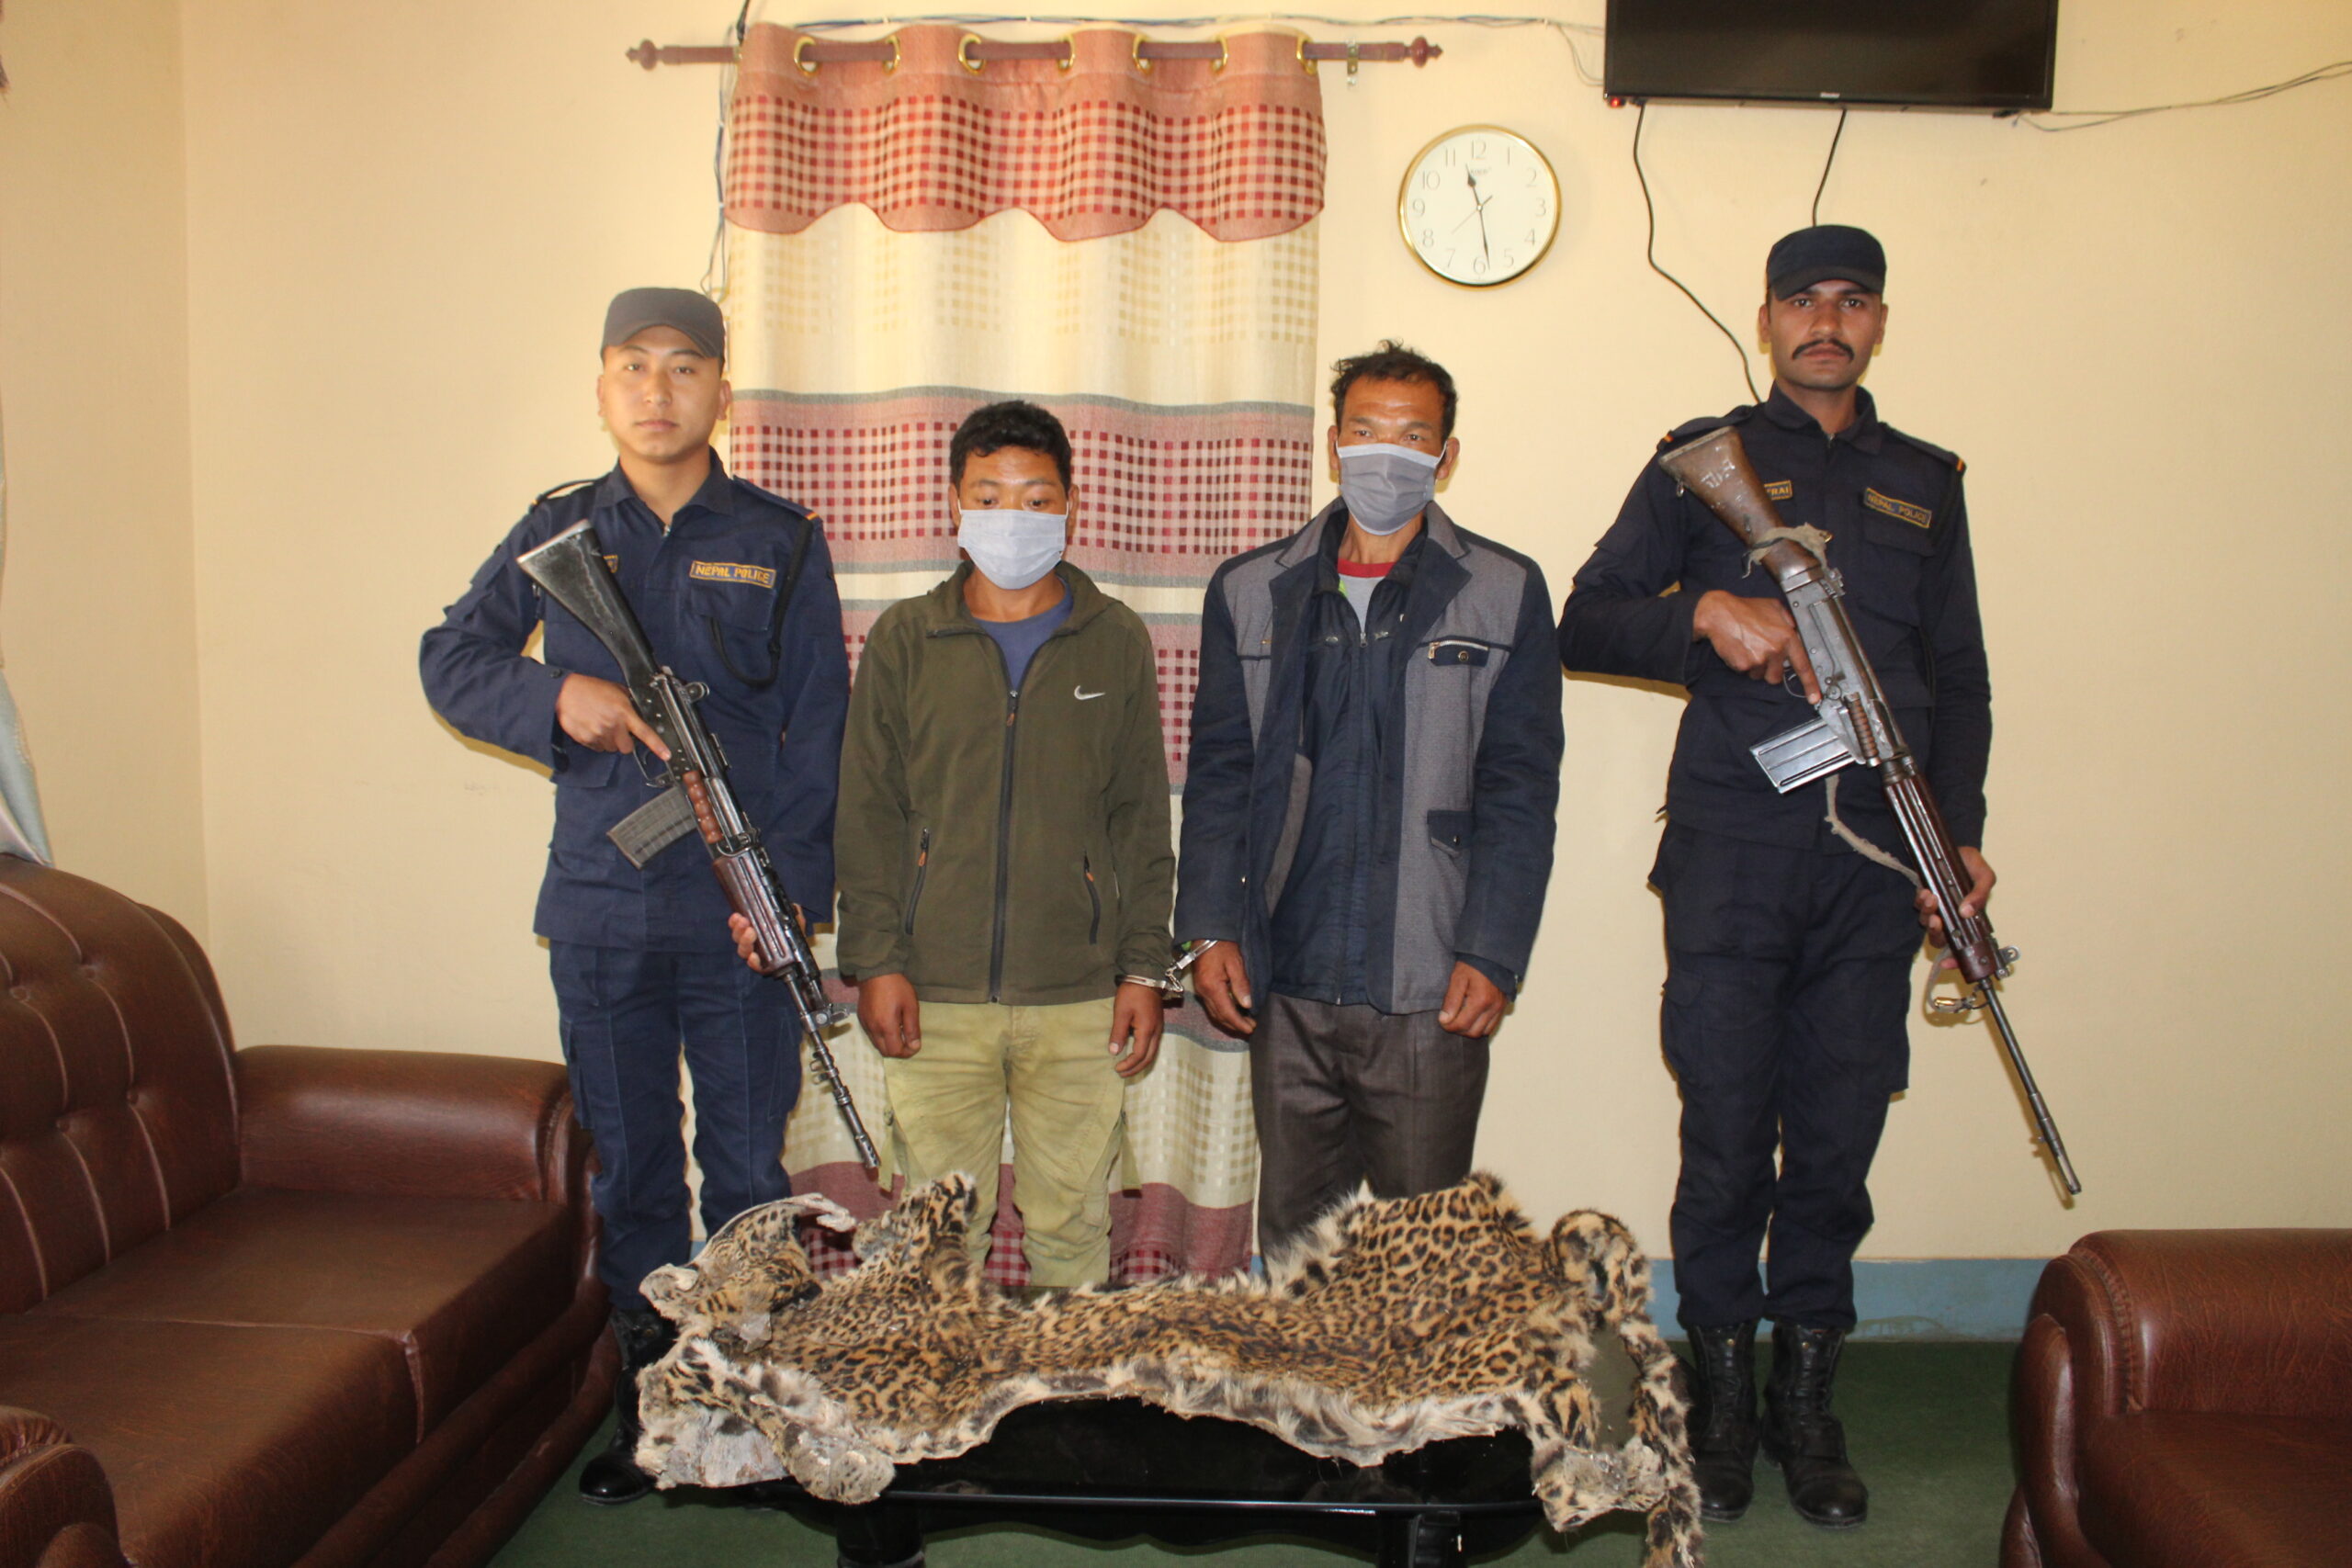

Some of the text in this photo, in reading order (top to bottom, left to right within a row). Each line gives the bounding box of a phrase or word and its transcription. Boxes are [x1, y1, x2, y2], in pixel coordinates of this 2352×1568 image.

[1445, 147, 1456, 166] 11
[1472, 140, 1487, 159] 12
[1423, 171, 1441, 190] 10
[1526, 168, 1537, 187] 2
[1412, 198, 1426, 217] 9
[1535, 197, 1546, 217] 3
[1423, 229, 1434, 248] 8
[1524, 229, 1535, 246] 4
[1446, 248, 1456, 268] 7
[1473, 255, 1487, 275] 6
[1503, 248, 1514, 267] 5
[1869, 494, 1927, 523] NEPAL POLICE
[695, 564, 770, 583] NEPAL POLICE
